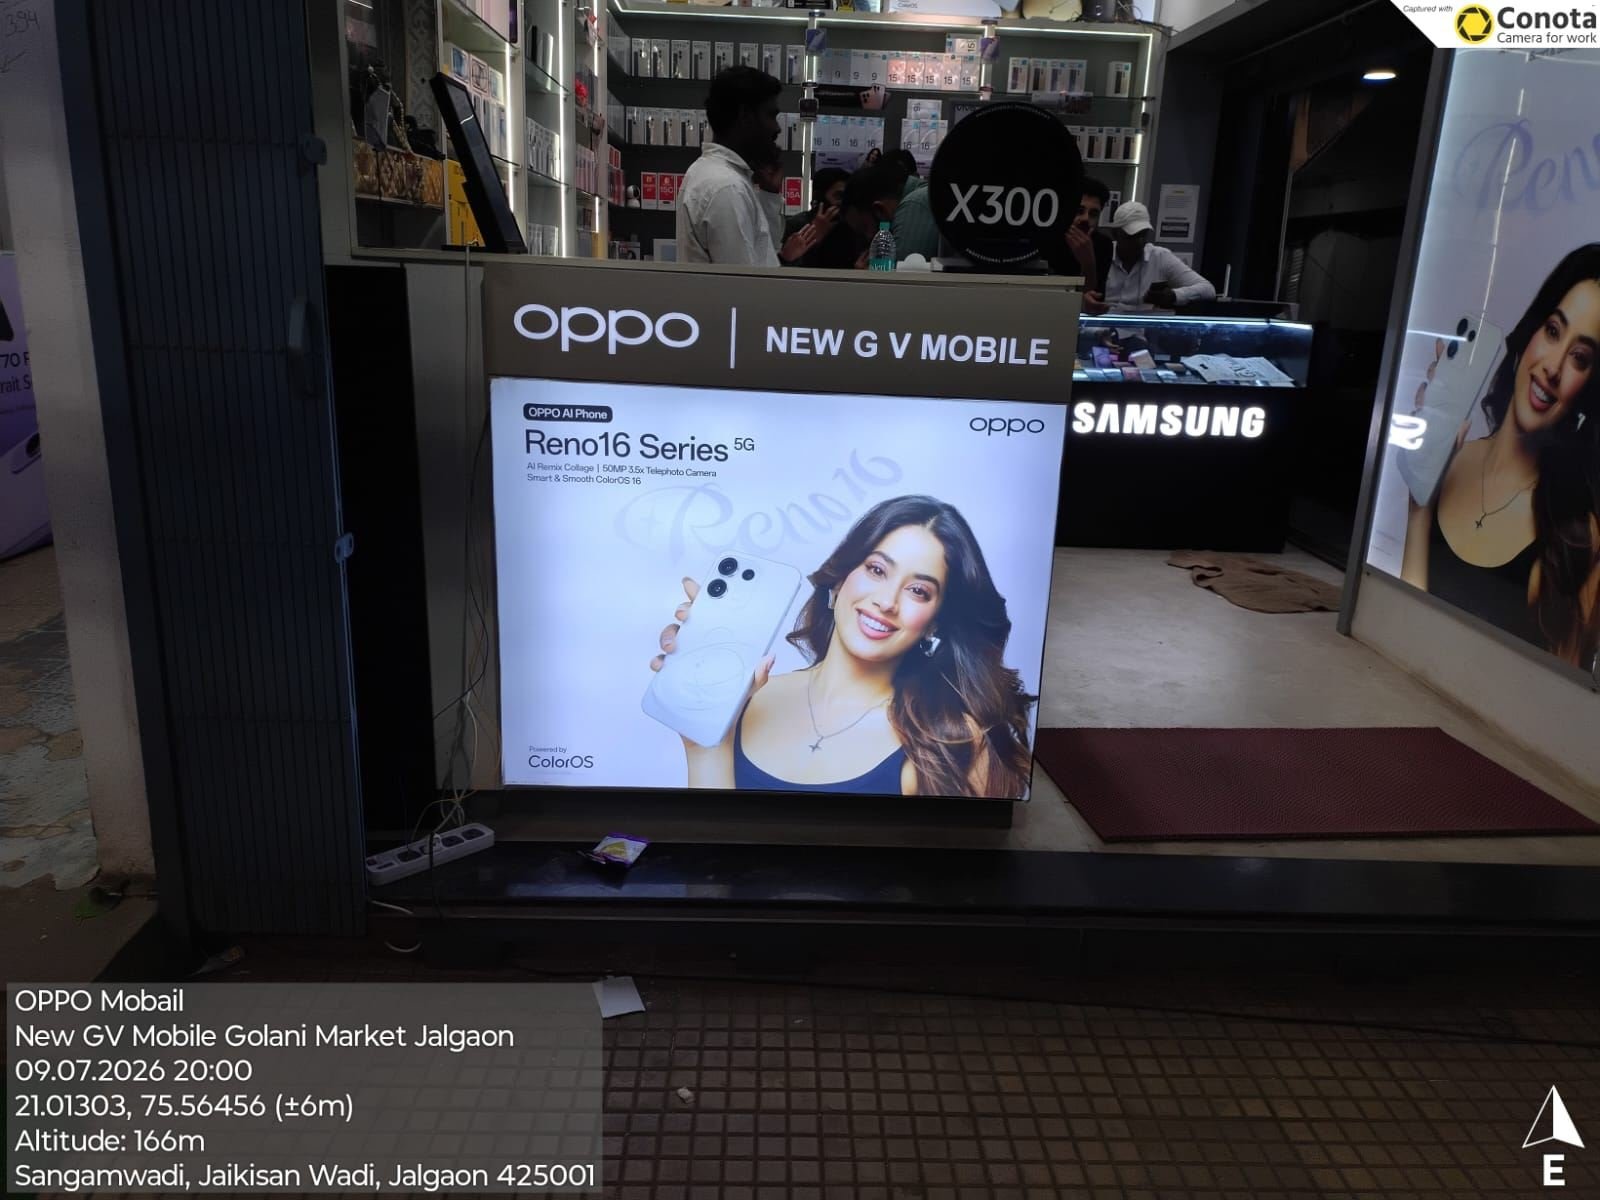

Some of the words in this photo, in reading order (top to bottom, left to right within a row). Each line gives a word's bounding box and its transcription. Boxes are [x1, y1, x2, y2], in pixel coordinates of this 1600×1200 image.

[888, 74, 898, 82] 15
[907, 75, 916, 83] 15
[925, 75, 935, 84] 15
[943, 76, 953, 85] 15
[962, 77, 971, 85] 15
[1453, 118, 1600, 222] Ren
[946, 182, 1060, 228] X300
[513, 303, 700, 355] oppo
[766, 326, 844, 355] NEW
[854, 330, 878, 358] G
[888, 332, 912, 359] V
[920, 333, 1050, 365] MOBILE
[528, 407, 560, 418] OPPO
[562, 408, 573, 418] AI
[575, 409, 608, 420] Phone
[1072, 402, 1267, 438] SAMSUNG
[969, 417, 1045, 436] oppo
[525, 428, 631, 458] Reno16
[639, 433, 729, 462] Series
[734, 437, 755, 451] 5G
[527, 462, 536, 470] AI
[537, 463, 563, 471] Remix
[564, 463, 594, 473] Collage
[602, 464, 627, 473] 50MP
[628, 466, 644, 474] 3.5x
[646, 467, 685, 477] Telephoto
[685, 468, 717, 477] Camera
[527, 474, 552, 482] Smart
[562, 475, 594, 483] Smooth
[596, 475, 631, 484] ColorOS
[632, 477, 642, 485] 16
[528, 755, 594, 768] ColorOS
